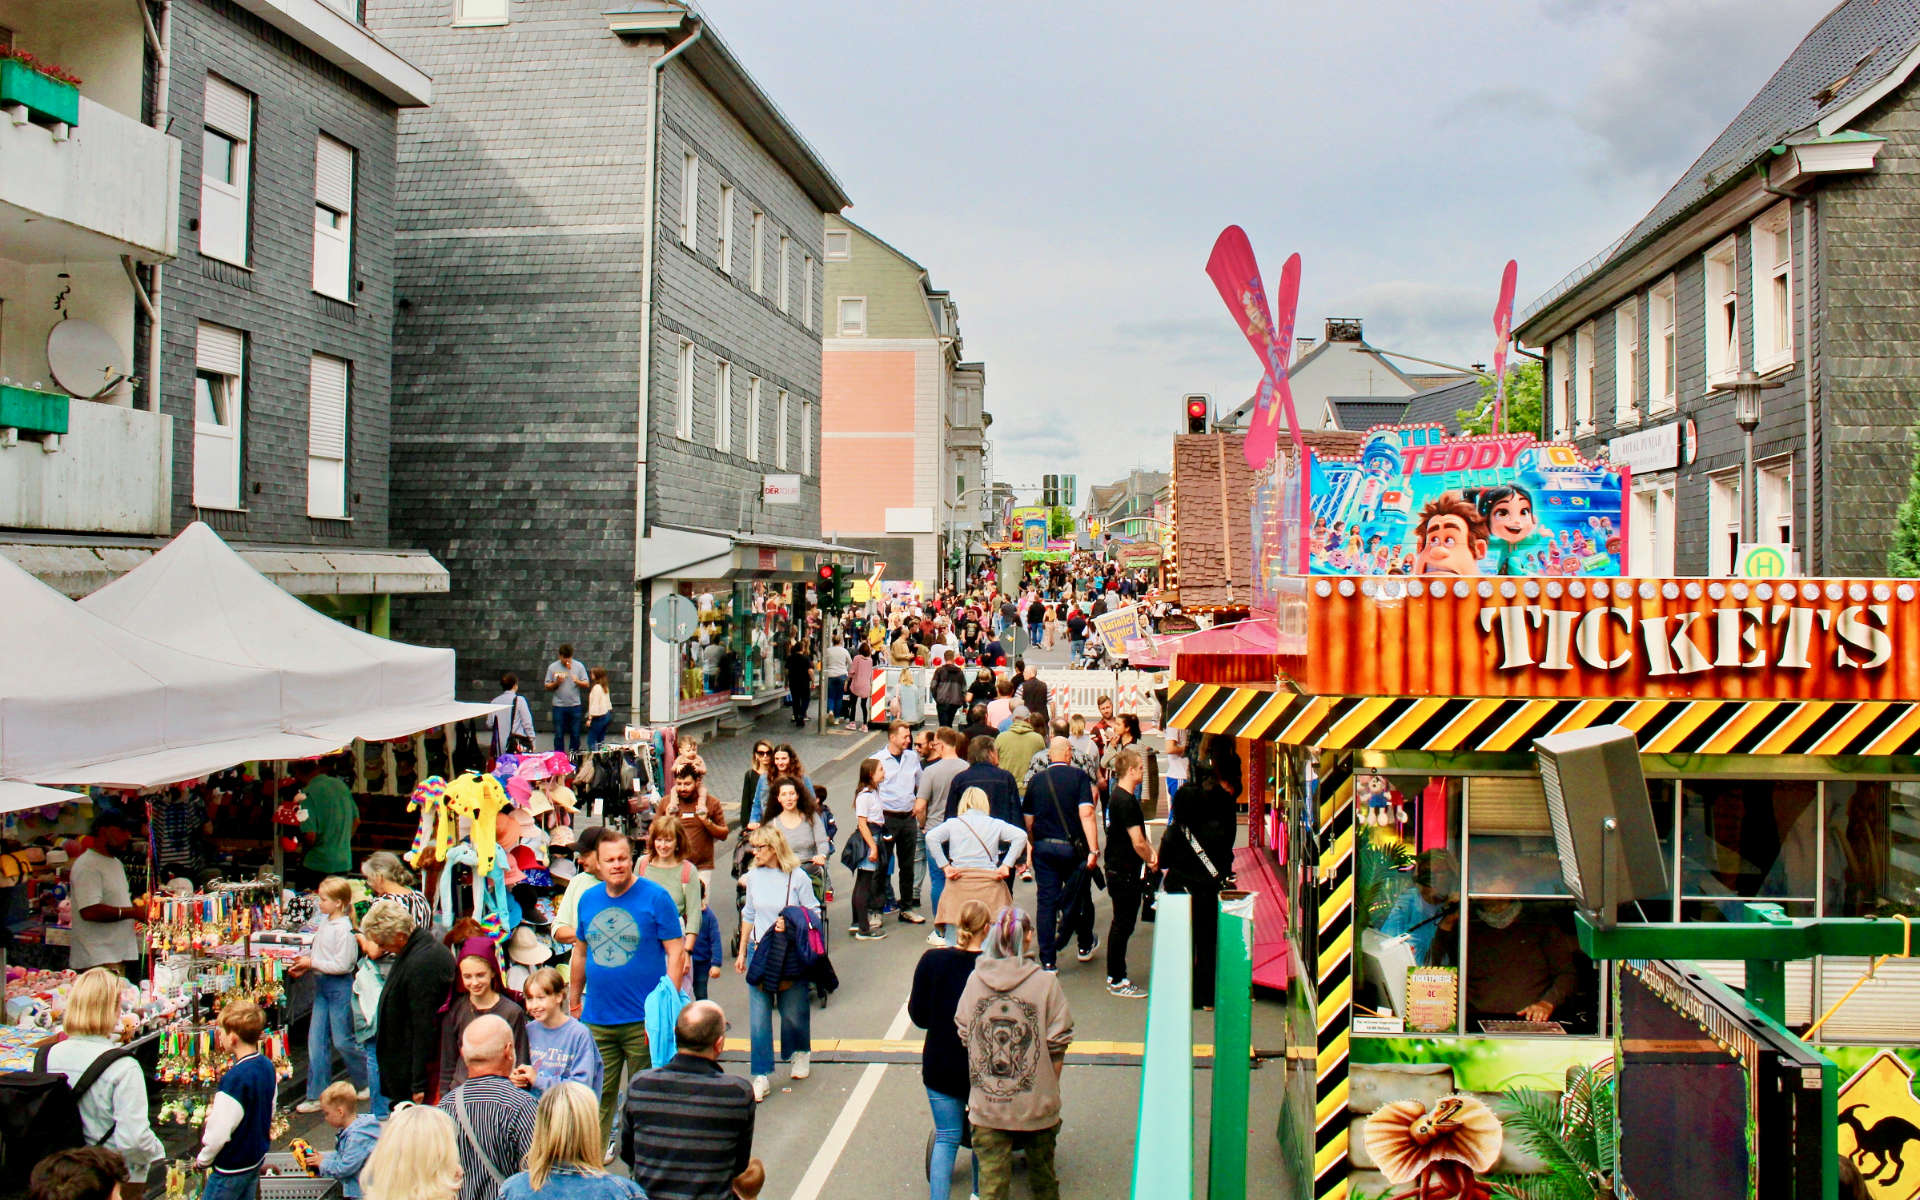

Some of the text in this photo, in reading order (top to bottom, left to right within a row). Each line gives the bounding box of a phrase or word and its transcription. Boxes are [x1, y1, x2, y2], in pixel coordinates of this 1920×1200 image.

[1398, 427, 1441, 447] THE
[1399, 437, 1529, 476] TEDDY
[1446, 468, 1517, 489] SHOP
[1480, 604, 1892, 676] TICKETS
[1641, 966, 1704, 1024] ACTION SIMULATOR
